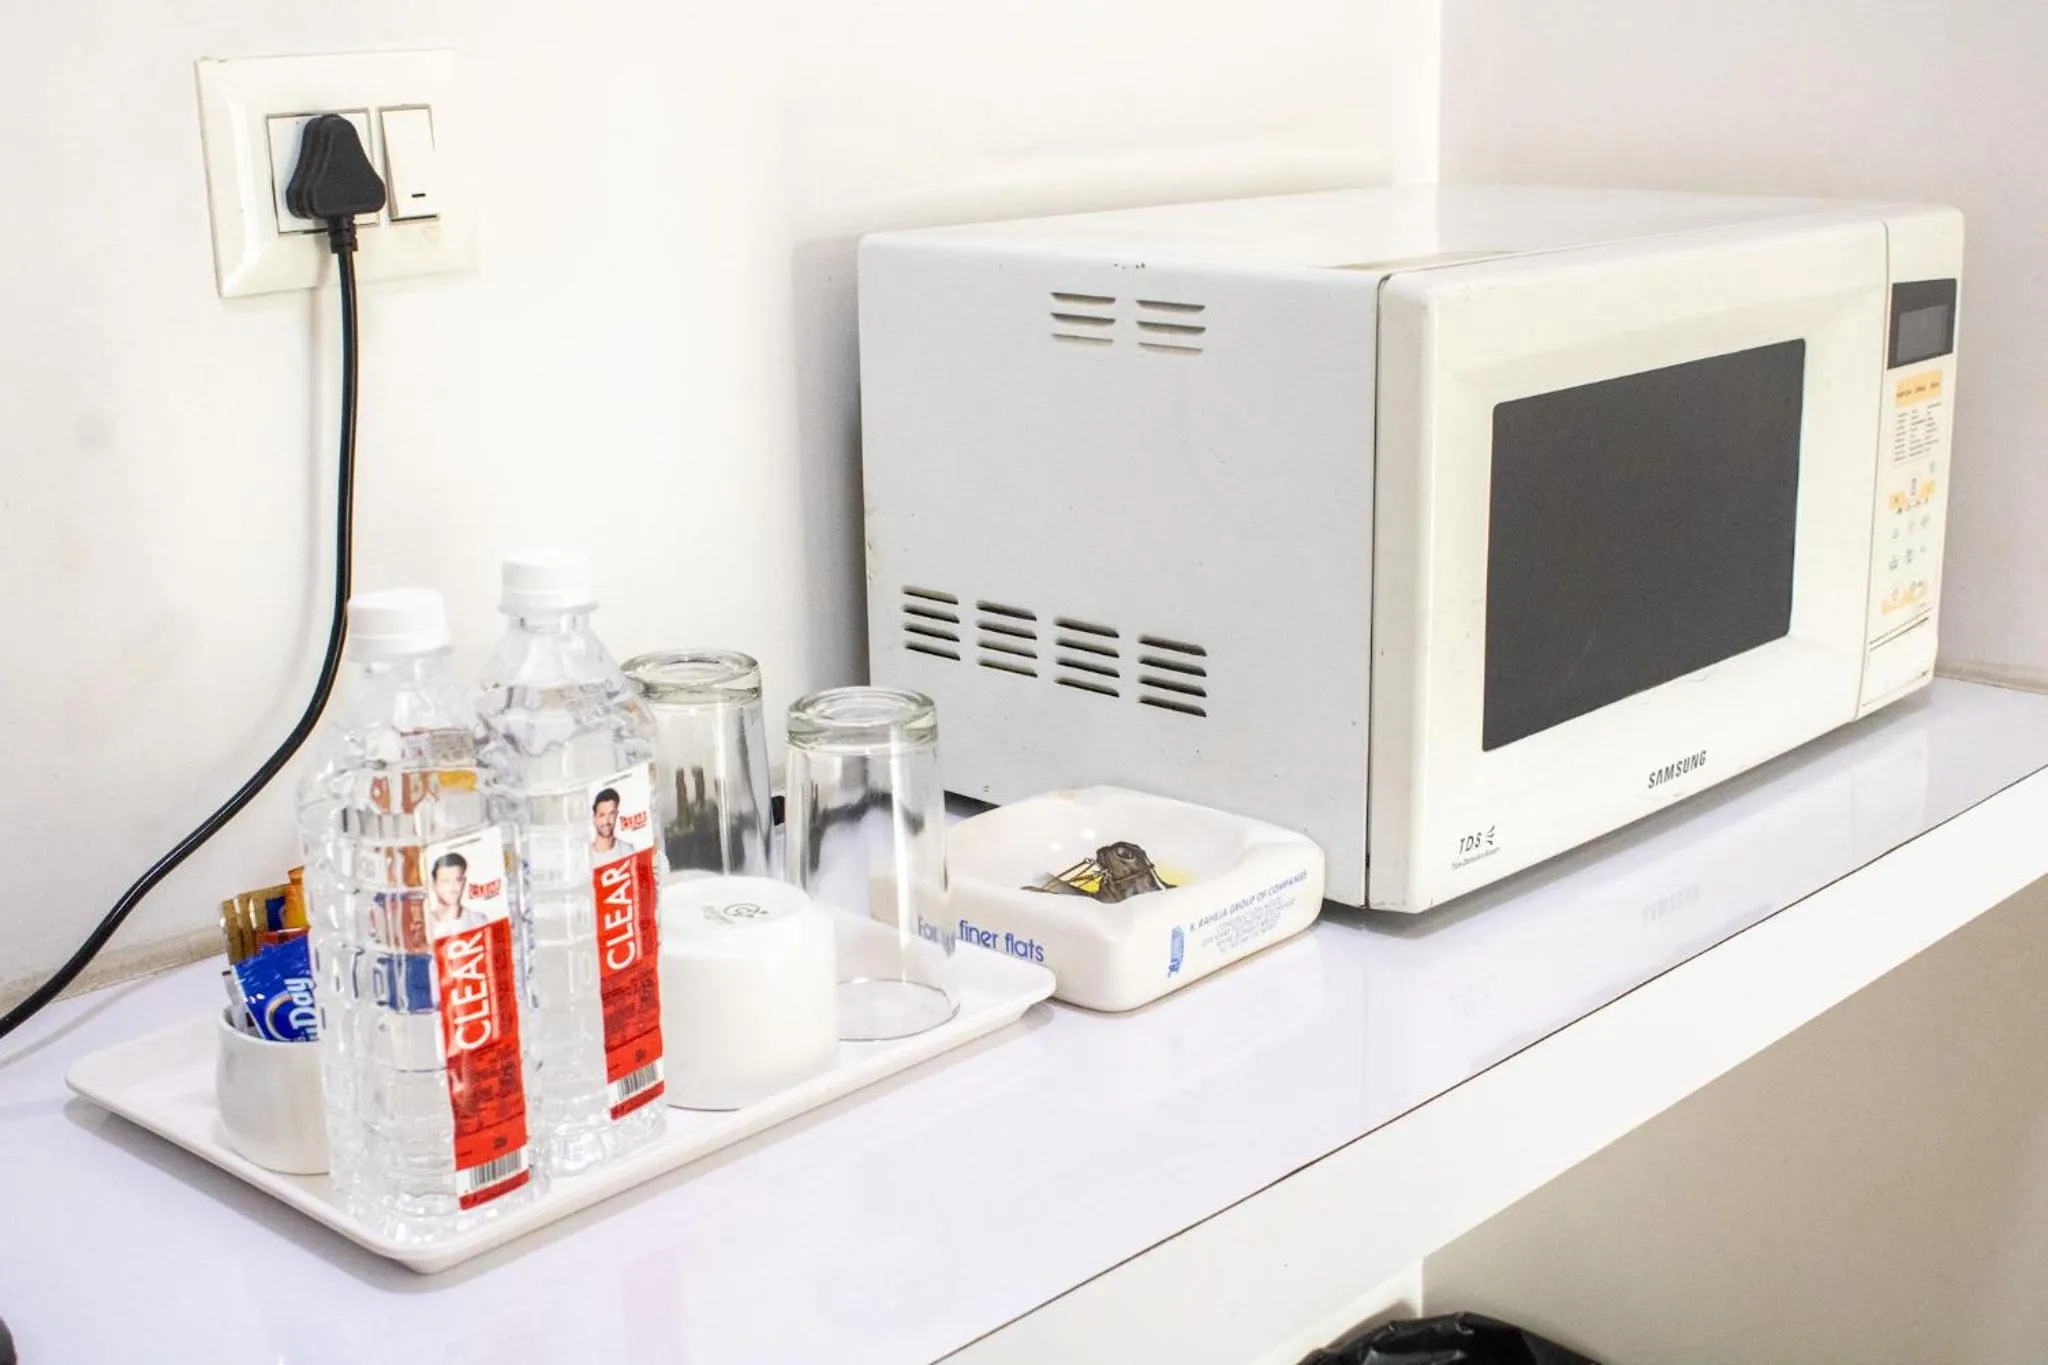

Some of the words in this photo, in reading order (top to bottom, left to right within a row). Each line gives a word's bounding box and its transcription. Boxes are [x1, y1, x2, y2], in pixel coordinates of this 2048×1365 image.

[1648, 750, 1706, 789] SAMSUNG
[1458, 832, 1482, 854] TDS
[1229, 896, 1255, 914] GROUP
[1256, 890, 1267, 902] OF
[1268, 869, 1307, 896] COMPANIES
[603, 858, 636, 971] CLEAR
[959, 920, 998, 948] finer
[1004, 933, 1044, 962] flats
[449, 931, 490, 1051] CLEAR
